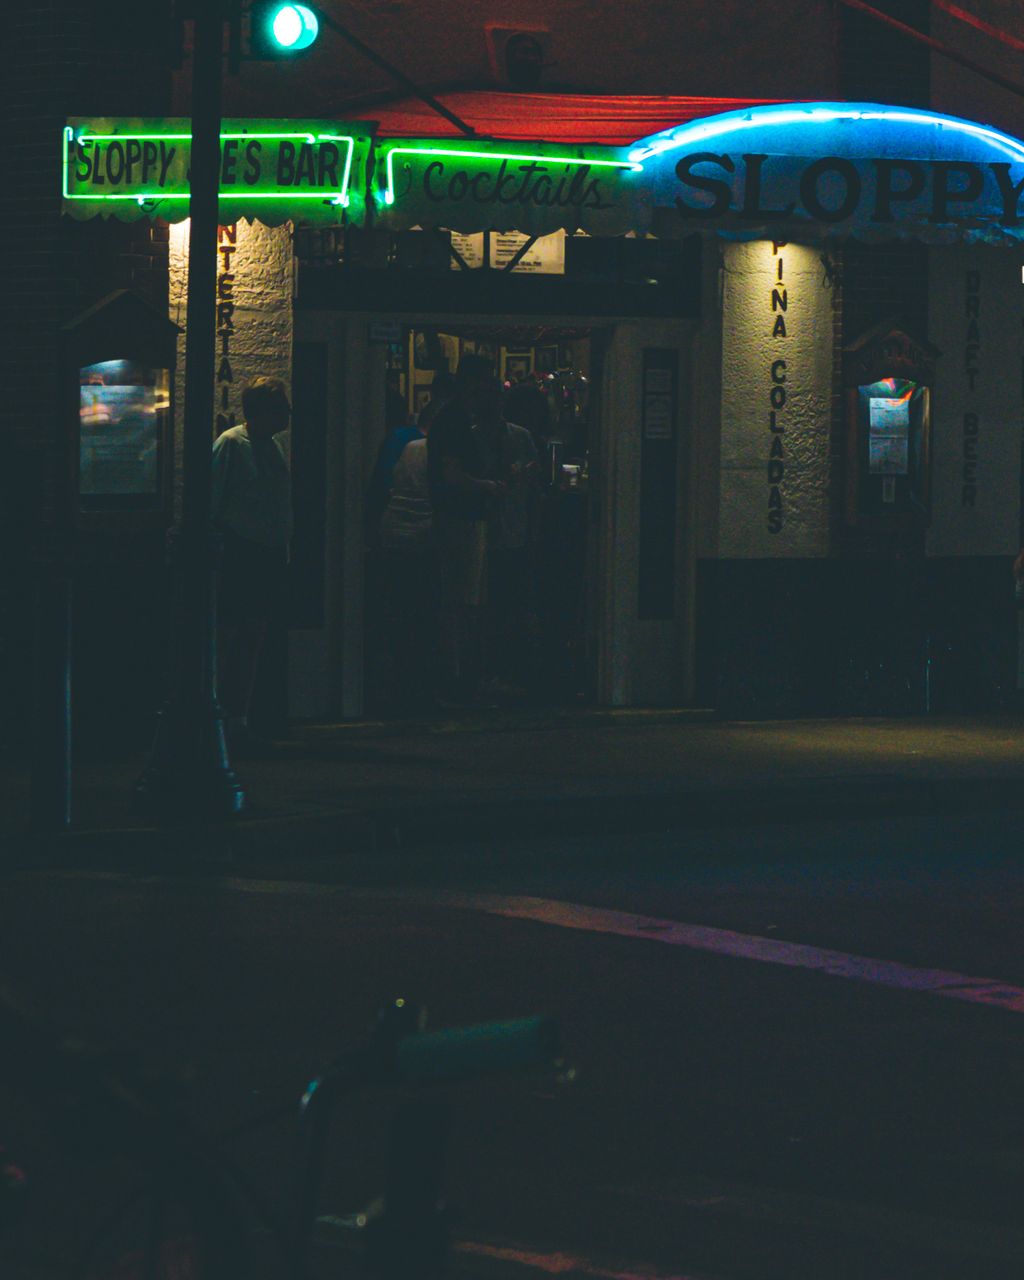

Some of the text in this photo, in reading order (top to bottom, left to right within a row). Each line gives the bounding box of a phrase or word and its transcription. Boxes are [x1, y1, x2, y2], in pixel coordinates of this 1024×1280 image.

[76, 139, 175, 187] SLOPPY
[276, 140, 339, 187] BAR
[423, 151, 613, 209] Cocktails
[768, 239, 788, 535] PIÑA COLADAS
[961, 269, 981, 508] DRAFT BEER
